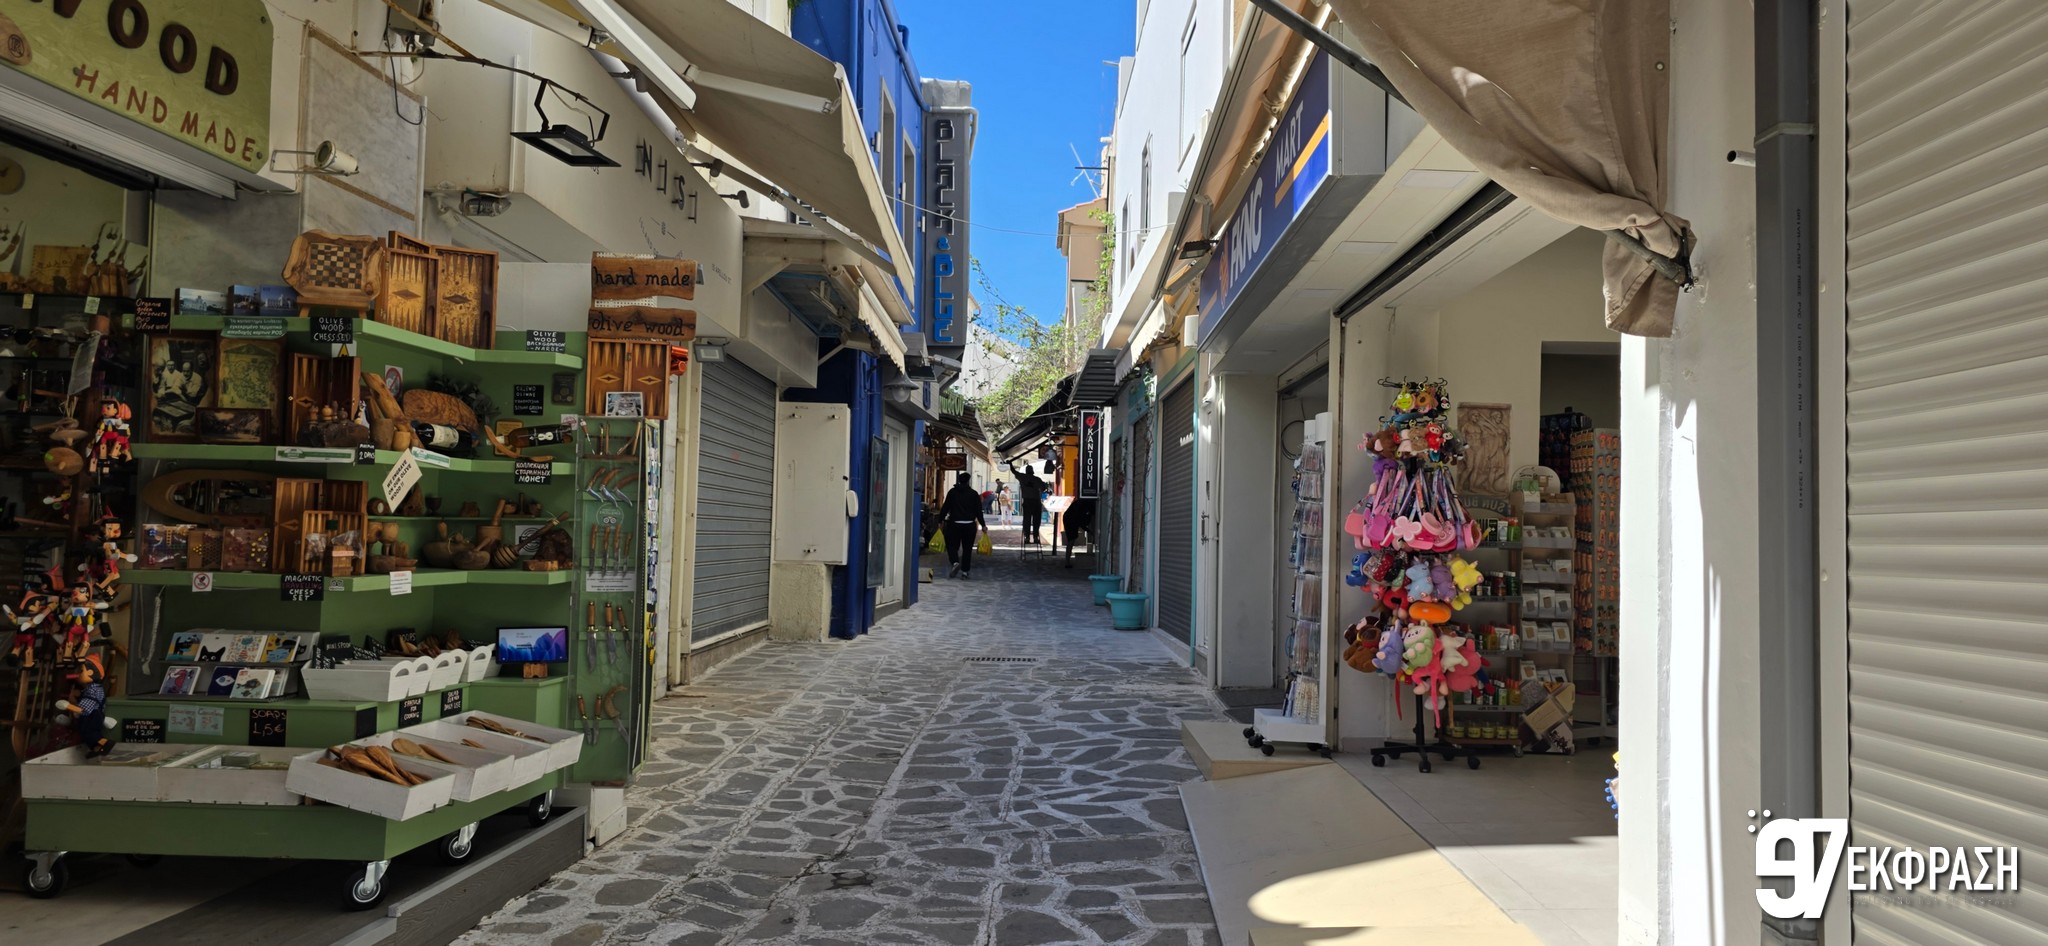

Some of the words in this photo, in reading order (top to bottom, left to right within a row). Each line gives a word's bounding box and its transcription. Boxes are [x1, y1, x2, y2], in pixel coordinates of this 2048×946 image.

[29, 0, 239, 95] OOD
[75, 64, 167, 123] HAND
[180, 111, 256, 162] MADE
[1274, 100, 1303, 188] MART
[637, 138, 698, 224] NISI
[936, 119, 955, 235] BLACK
[937, 236, 950, 250] &
[593, 266, 637, 286] hand
[645, 267, 690, 287] made
[934, 253, 953, 342] BLUE
[313, 332, 335, 342] CHESS
[319, 317, 343, 325] OLIVE
[320, 324, 344, 332] WOOD
[591, 312, 634, 332] olive
[643, 318, 685, 337] wood
